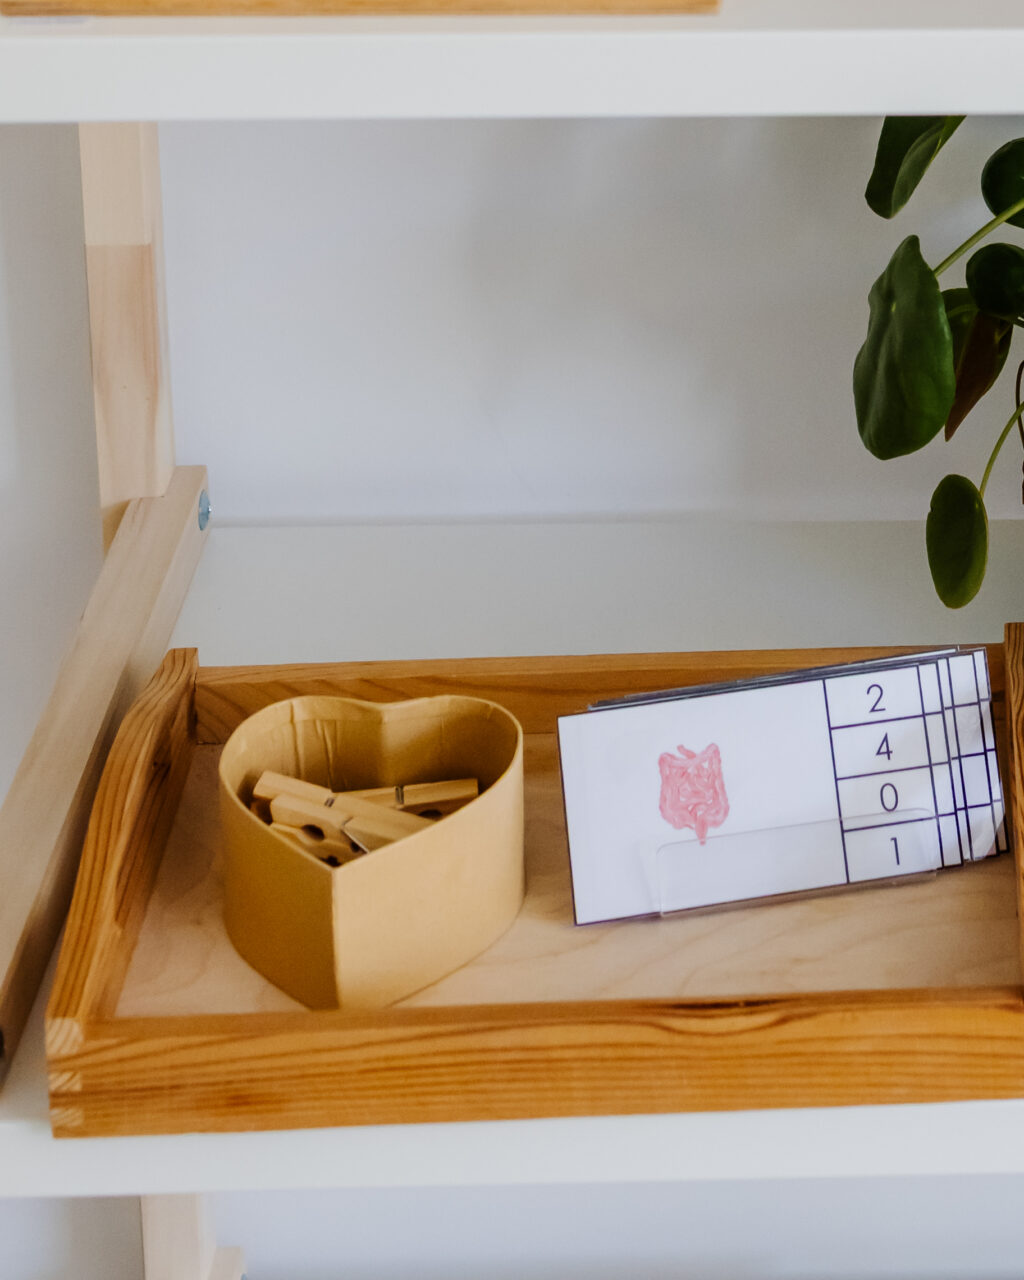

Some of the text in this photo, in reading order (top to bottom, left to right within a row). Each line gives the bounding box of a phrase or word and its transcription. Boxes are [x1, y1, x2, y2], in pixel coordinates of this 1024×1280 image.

[866, 684, 886, 713] 2
[875, 732, 893, 761] 4
[880, 782, 899, 812] 0
[890, 837, 900, 866] 1
